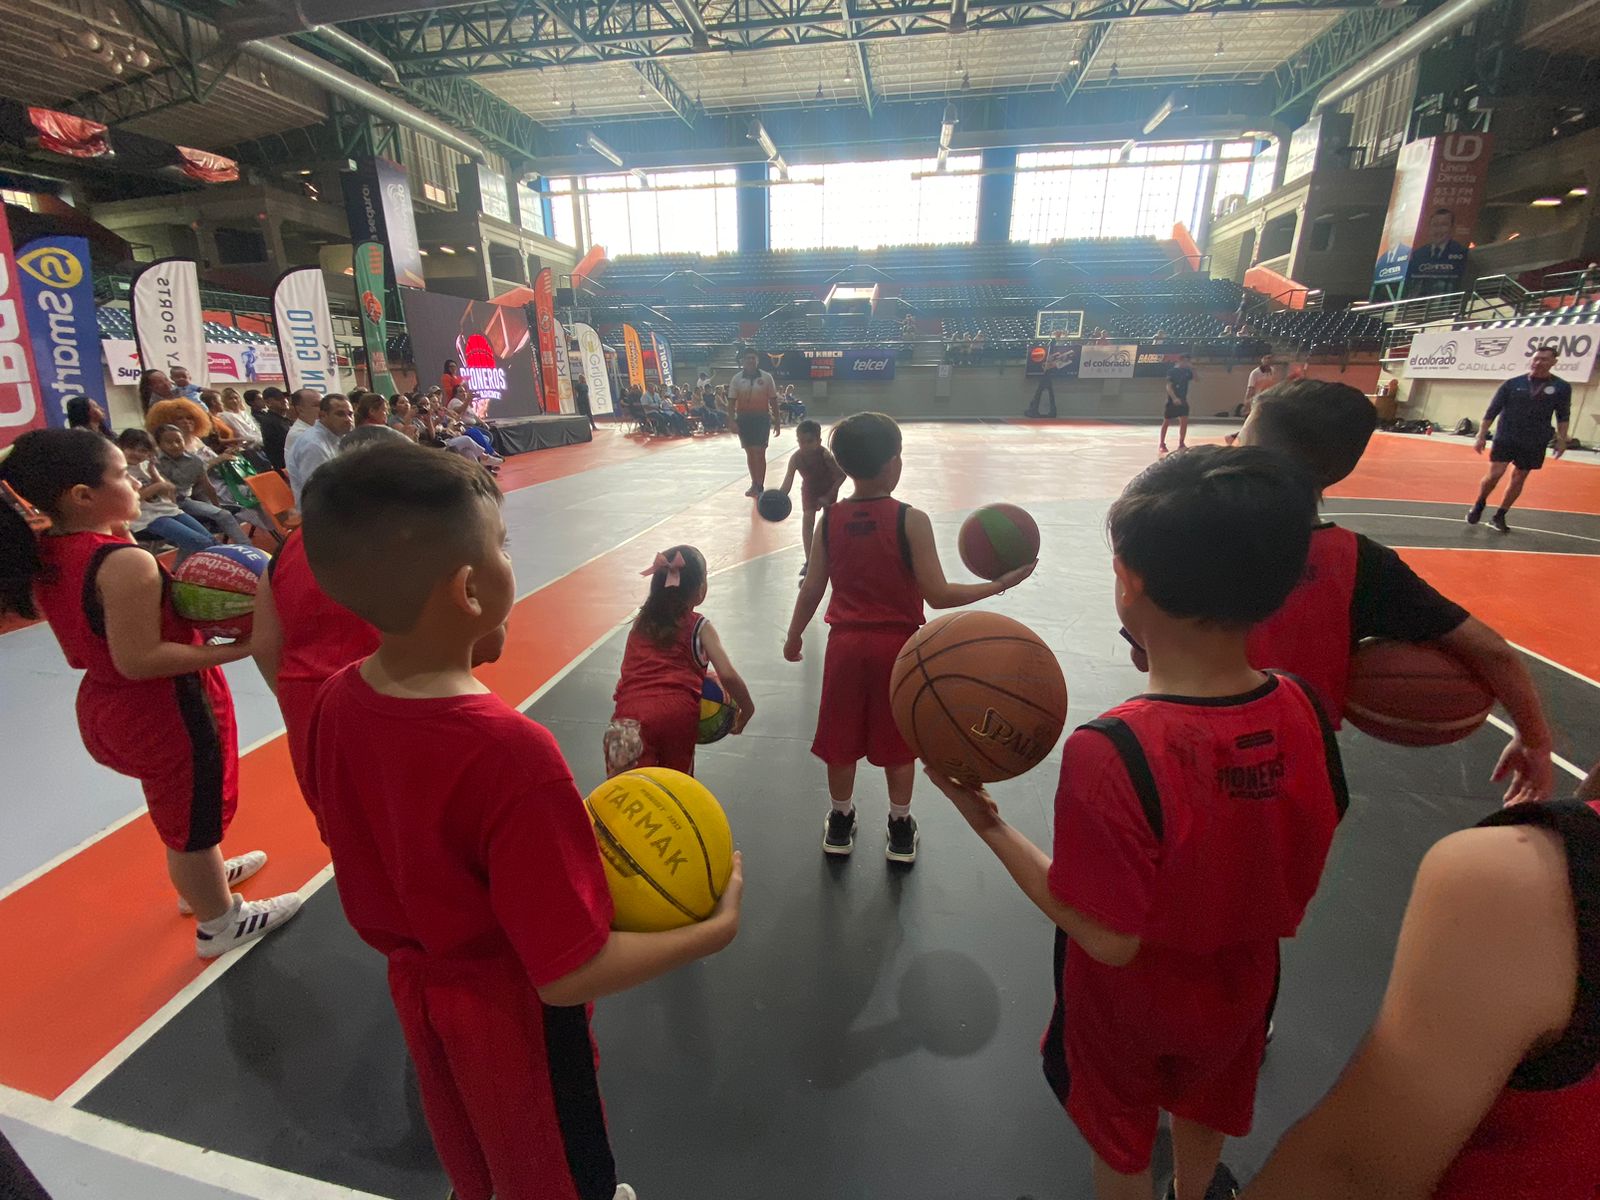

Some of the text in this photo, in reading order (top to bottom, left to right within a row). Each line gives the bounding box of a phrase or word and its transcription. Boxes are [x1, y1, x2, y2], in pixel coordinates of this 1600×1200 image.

[658, 343, 671, 375] ROBLE
[852, 358, 889, 372] telcel
[1083, 359, 1091, 368] el
[1092, 358, 1131, 368] colorado
[1409, 354, 1457, 366] el colorado
[117, 366, 141, 380] Sup
[1457, 362, 1516, 372] CADILLAC
[603, 784, 689, 877] TARMAK
